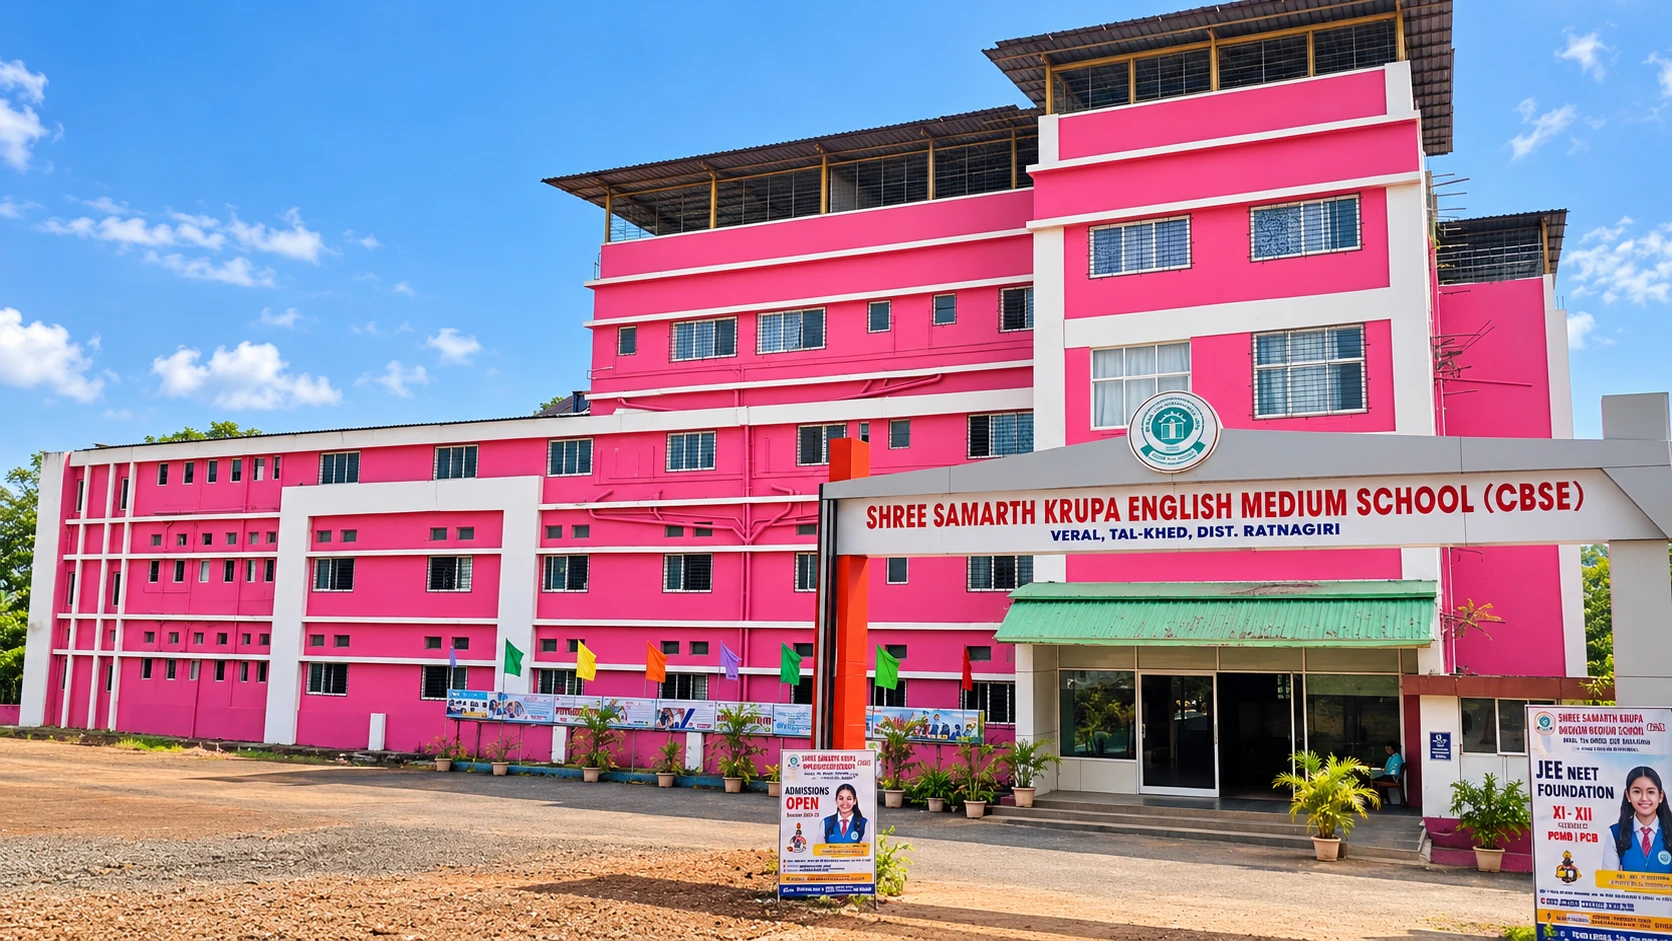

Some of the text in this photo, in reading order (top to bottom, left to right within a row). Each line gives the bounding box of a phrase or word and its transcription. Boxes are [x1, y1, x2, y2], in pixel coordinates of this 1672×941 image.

[866, 481, 1585, 529] SHREE SAMARTH KRUPA ENGLISH MEDIUM SCHOOL (CBSE)
[1050, 523, 1340, 543] VERAL, TAL-KHED, DIST. RATNAGIRI
[1536, 760, 1599, 781] JEE NEET
[785, 786, 830, 796] ADMISSIONS
[1537, 784, 1615, 800] FOUNDATION
[786, 796, 819, 810] OPEN
[1553, 805, 1566, 820] XI
[1575, 806, 1593, 821] XII
